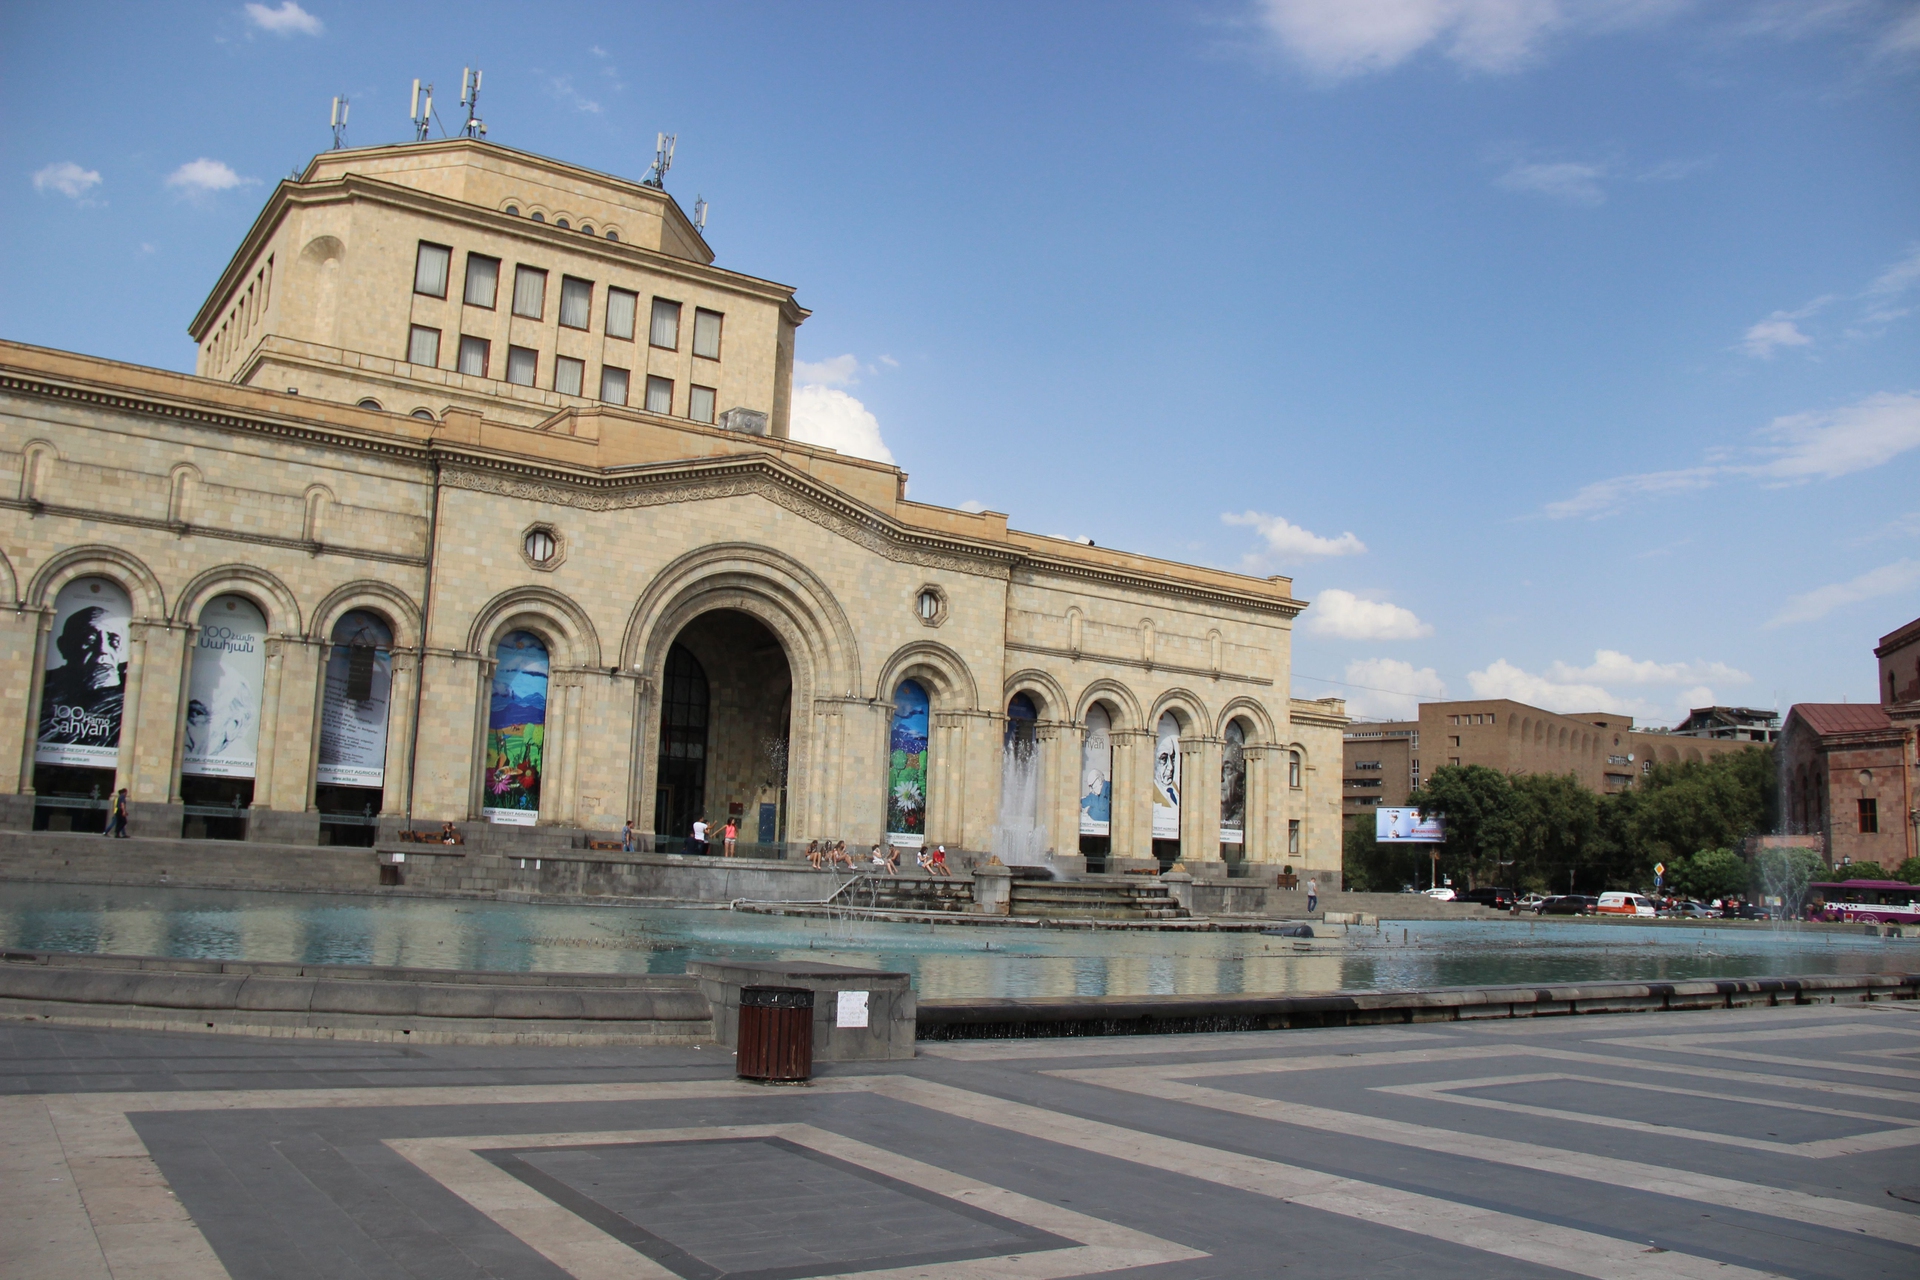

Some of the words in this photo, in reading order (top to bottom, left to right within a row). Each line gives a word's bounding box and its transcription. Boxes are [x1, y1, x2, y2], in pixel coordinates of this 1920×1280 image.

[53, 704, 84, 720] 100
[83, 716, 110, 725] Hamo
[51, 718, 109, 738] Sahyan
[826, 990, 905, 1046] FCK
